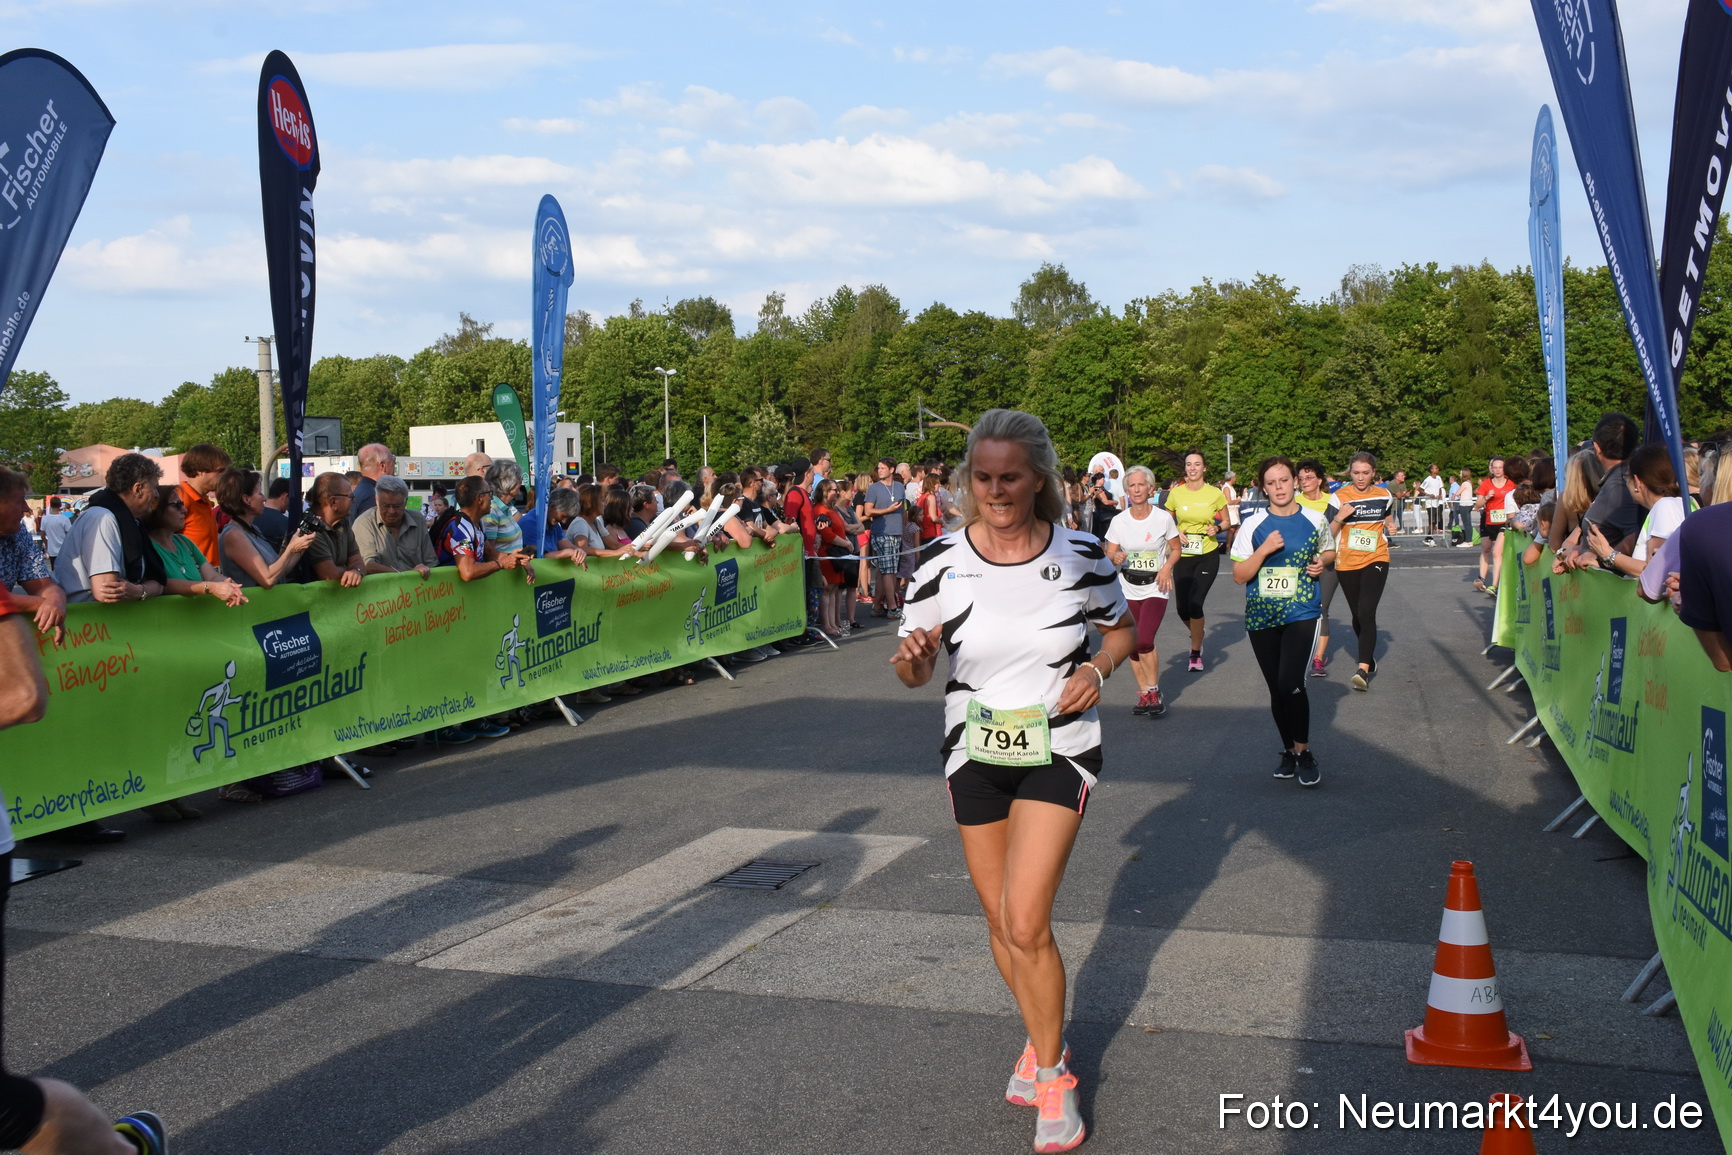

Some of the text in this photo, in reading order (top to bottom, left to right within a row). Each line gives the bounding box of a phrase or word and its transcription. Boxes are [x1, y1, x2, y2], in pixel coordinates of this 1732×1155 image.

[2, 99, 59, 211] Fischer
[26, 121, 68, 211] AUTOMOBILE
[1355, 535, 1371, 545] 769
[1131, 560, 1155, 569] 1316
[1266, 578, 1289, 589] 270
[356, 581, 455, 624] Gesunde Firmen
[542, 596, 567, 610] Fischer
[704, 586, 758, 630] firmenlauf
[385, 597, 467, 645] laufen länger!
[706, 623, 731, 640] neumarkt
[272, 635, 310, 653] Fischer
[280, 645, 311, 660] AUTOMOBILE
[525, 612, 602, 668] firmenlauf
[57, 642, 139, 692] länger!
[528, 659, 563, 681] neumarkt
[240, 651, 367, 731] firmenlauf
[333, 691, 476, 743] www.firmenlauf-oberpfalz.de
[243, 717, 302, 749] neumarkt
[980, 726, 1029, 750] 794
[974, 745, 1015, 758] Haberstumpf
[1706, 750, 1723, 781] Fischer
[1678, 905, 1707, 951] neumarkt
